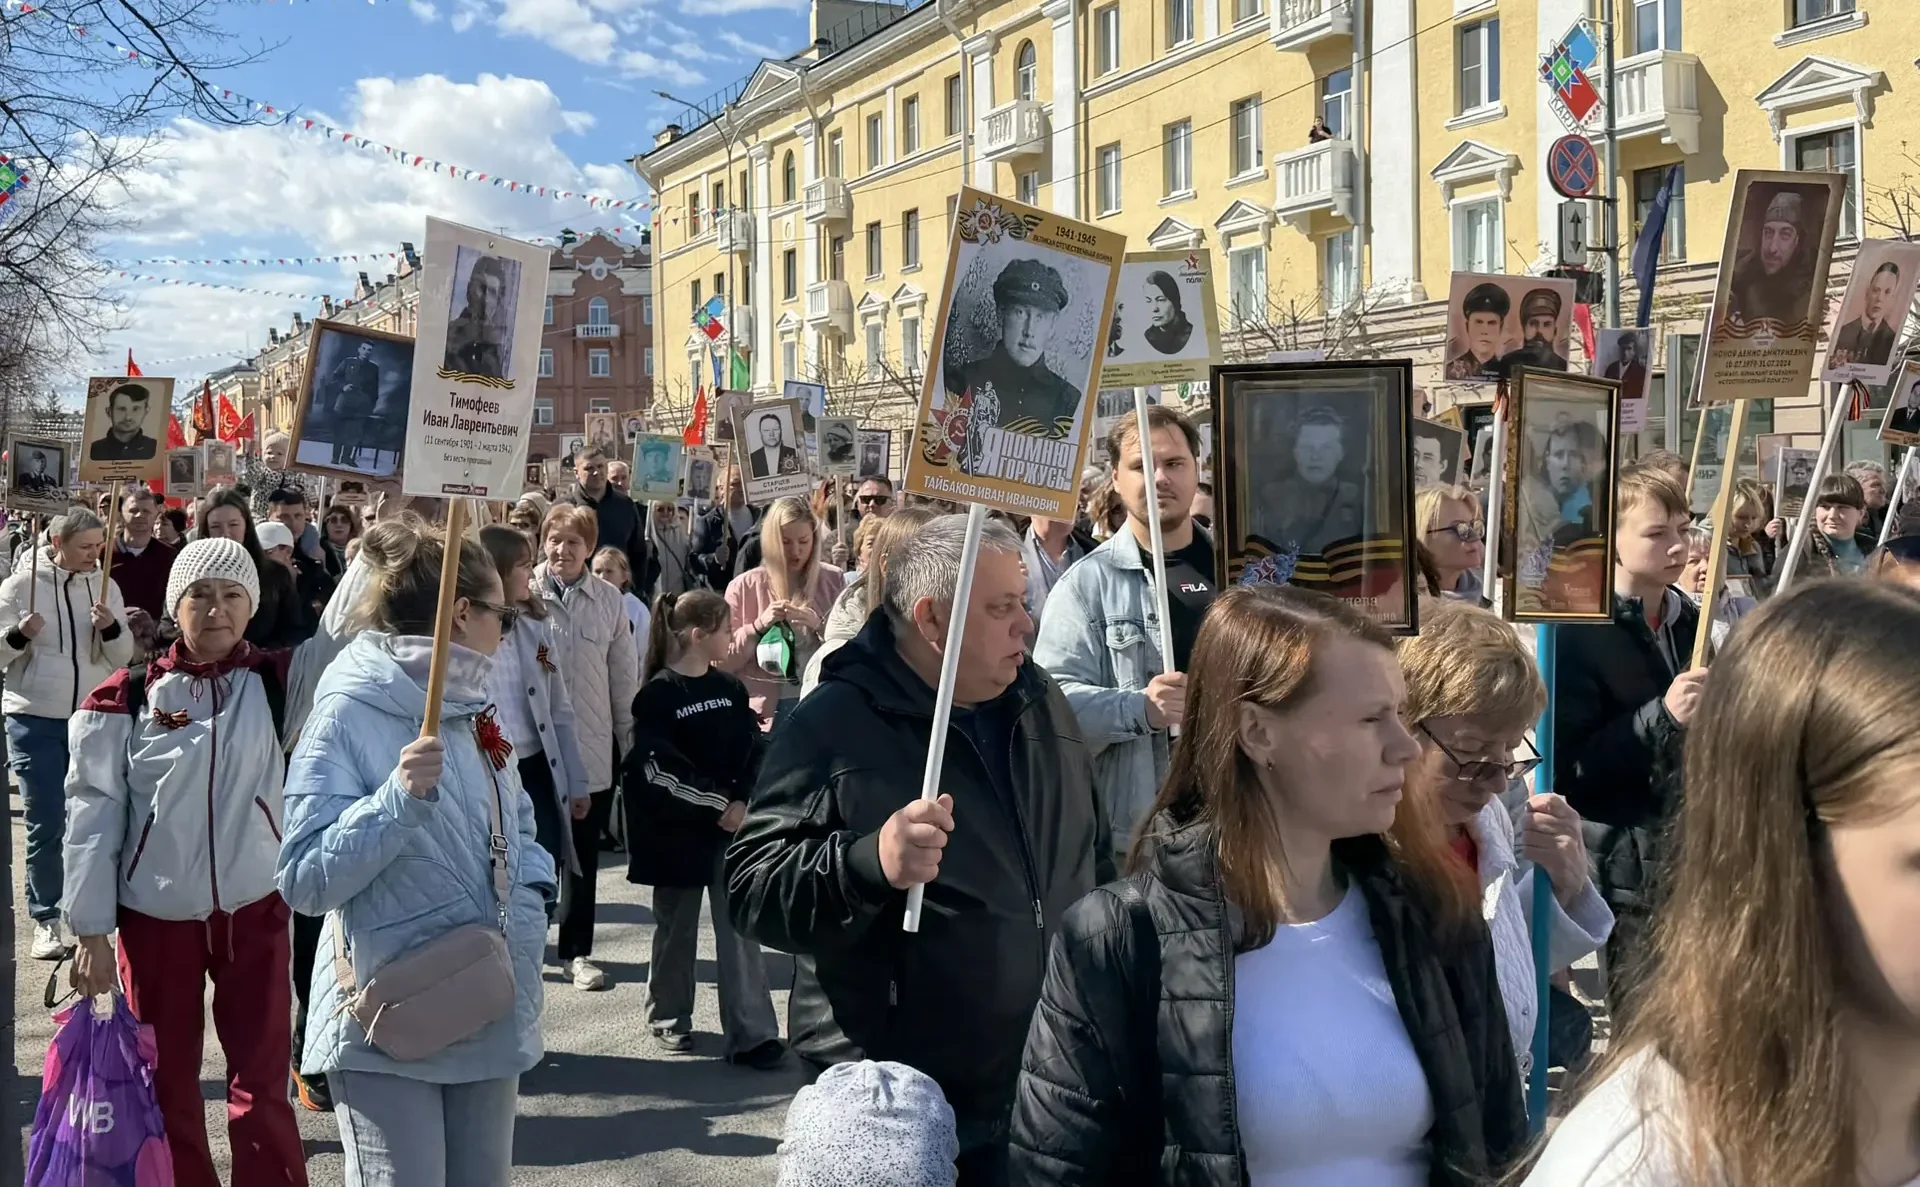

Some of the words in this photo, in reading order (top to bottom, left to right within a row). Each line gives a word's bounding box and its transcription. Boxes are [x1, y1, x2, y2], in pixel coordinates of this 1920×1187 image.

[1056, 226, 1097, 246] 1941-1945
[449, 391, 500, 416] Тимофеев
[423, 409, 449, 428] Иван
[450, 413, 519, 437] Лаврентьевич
[424, 434, 433, 445] (11
[434, 437, 459, 449] сентября
[460, 438, 473, 450] 1901
[924, 475, 976, 497] ТАЙБАКОВ
[977, 488, 1004, 503] ИВАН
[1006, 493, 1060, 513] ИВАНОВИЧ
[1180, 582, 1208, 593] FILA
[69, 1092, 114, 1134] WB
